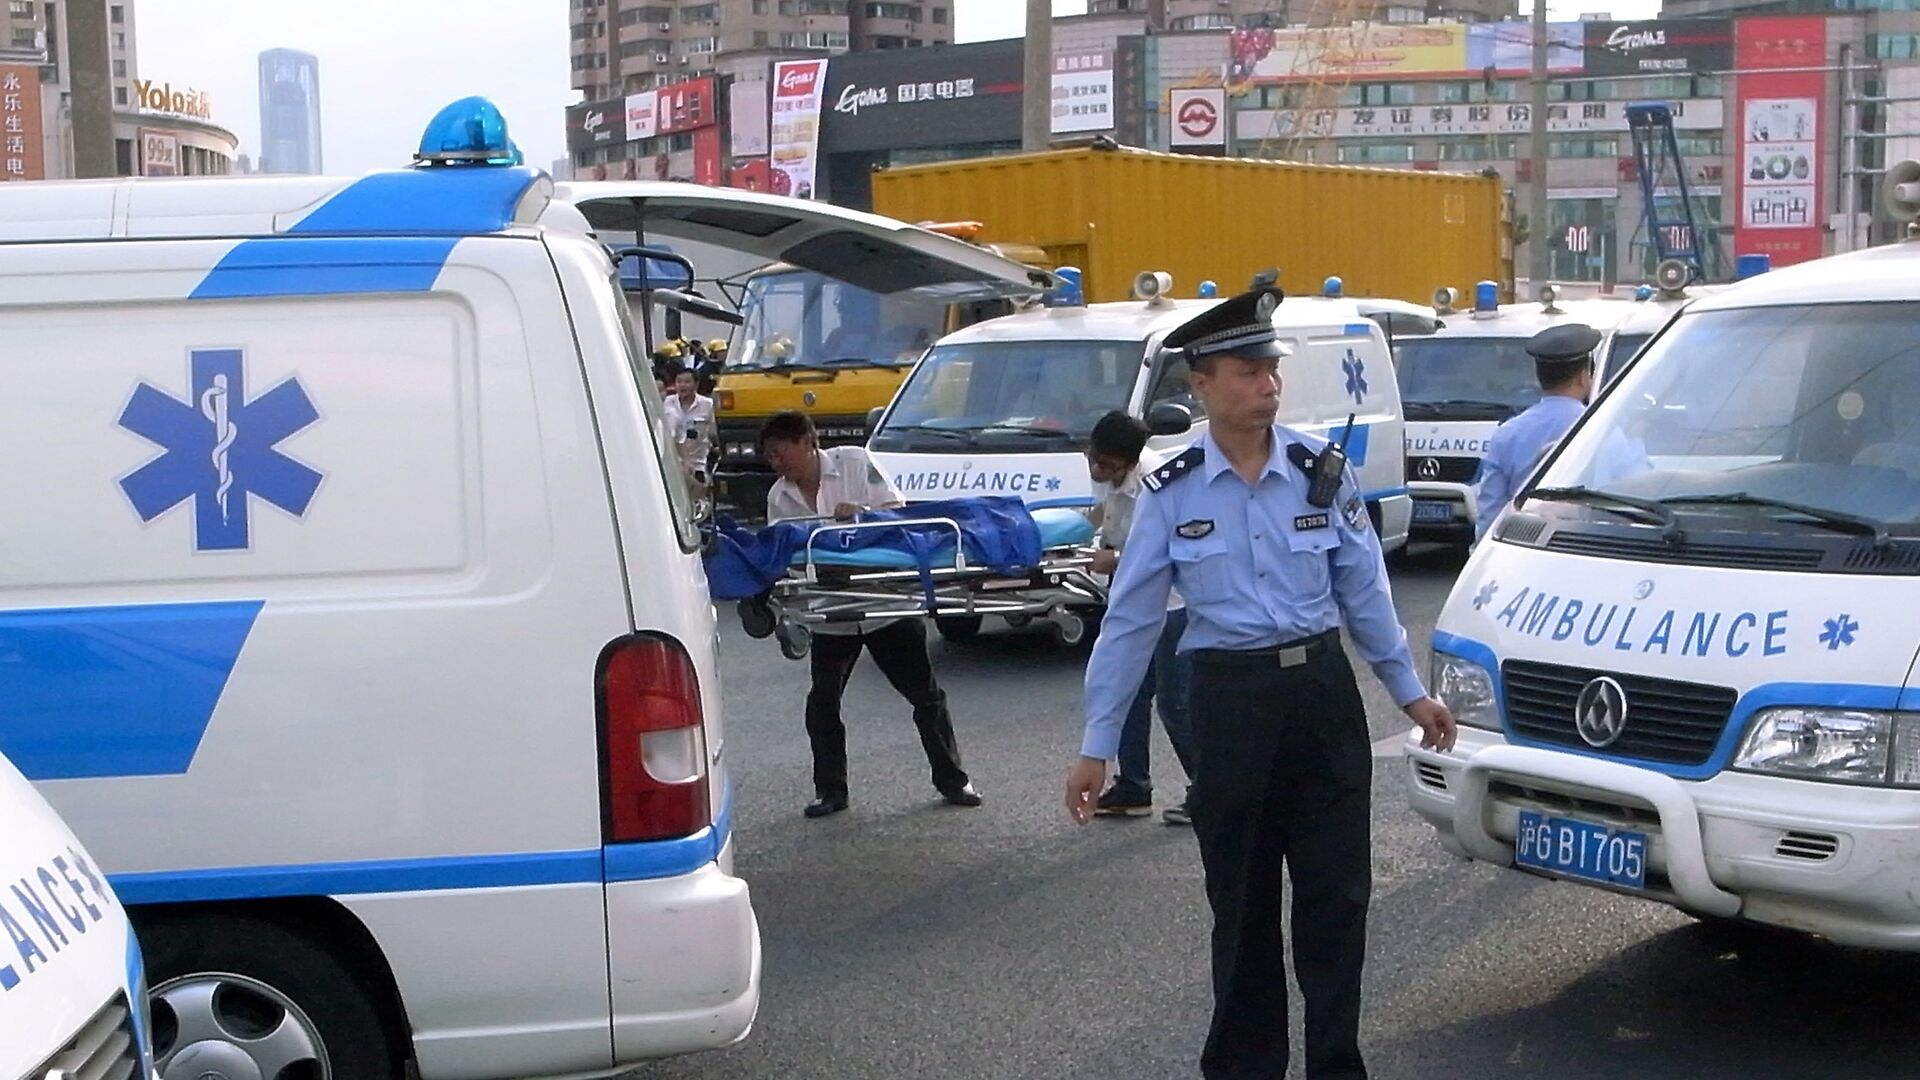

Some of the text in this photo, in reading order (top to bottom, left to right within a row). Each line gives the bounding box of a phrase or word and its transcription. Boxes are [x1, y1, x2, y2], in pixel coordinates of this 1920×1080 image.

[898, 78, 974, 103] 国美电器
[4, 72, 24, 179] 永乐生活电
[894, 472, 1041, 491] AMBULANCE
[1497, 586, 1789, 657] AMBULANCE
